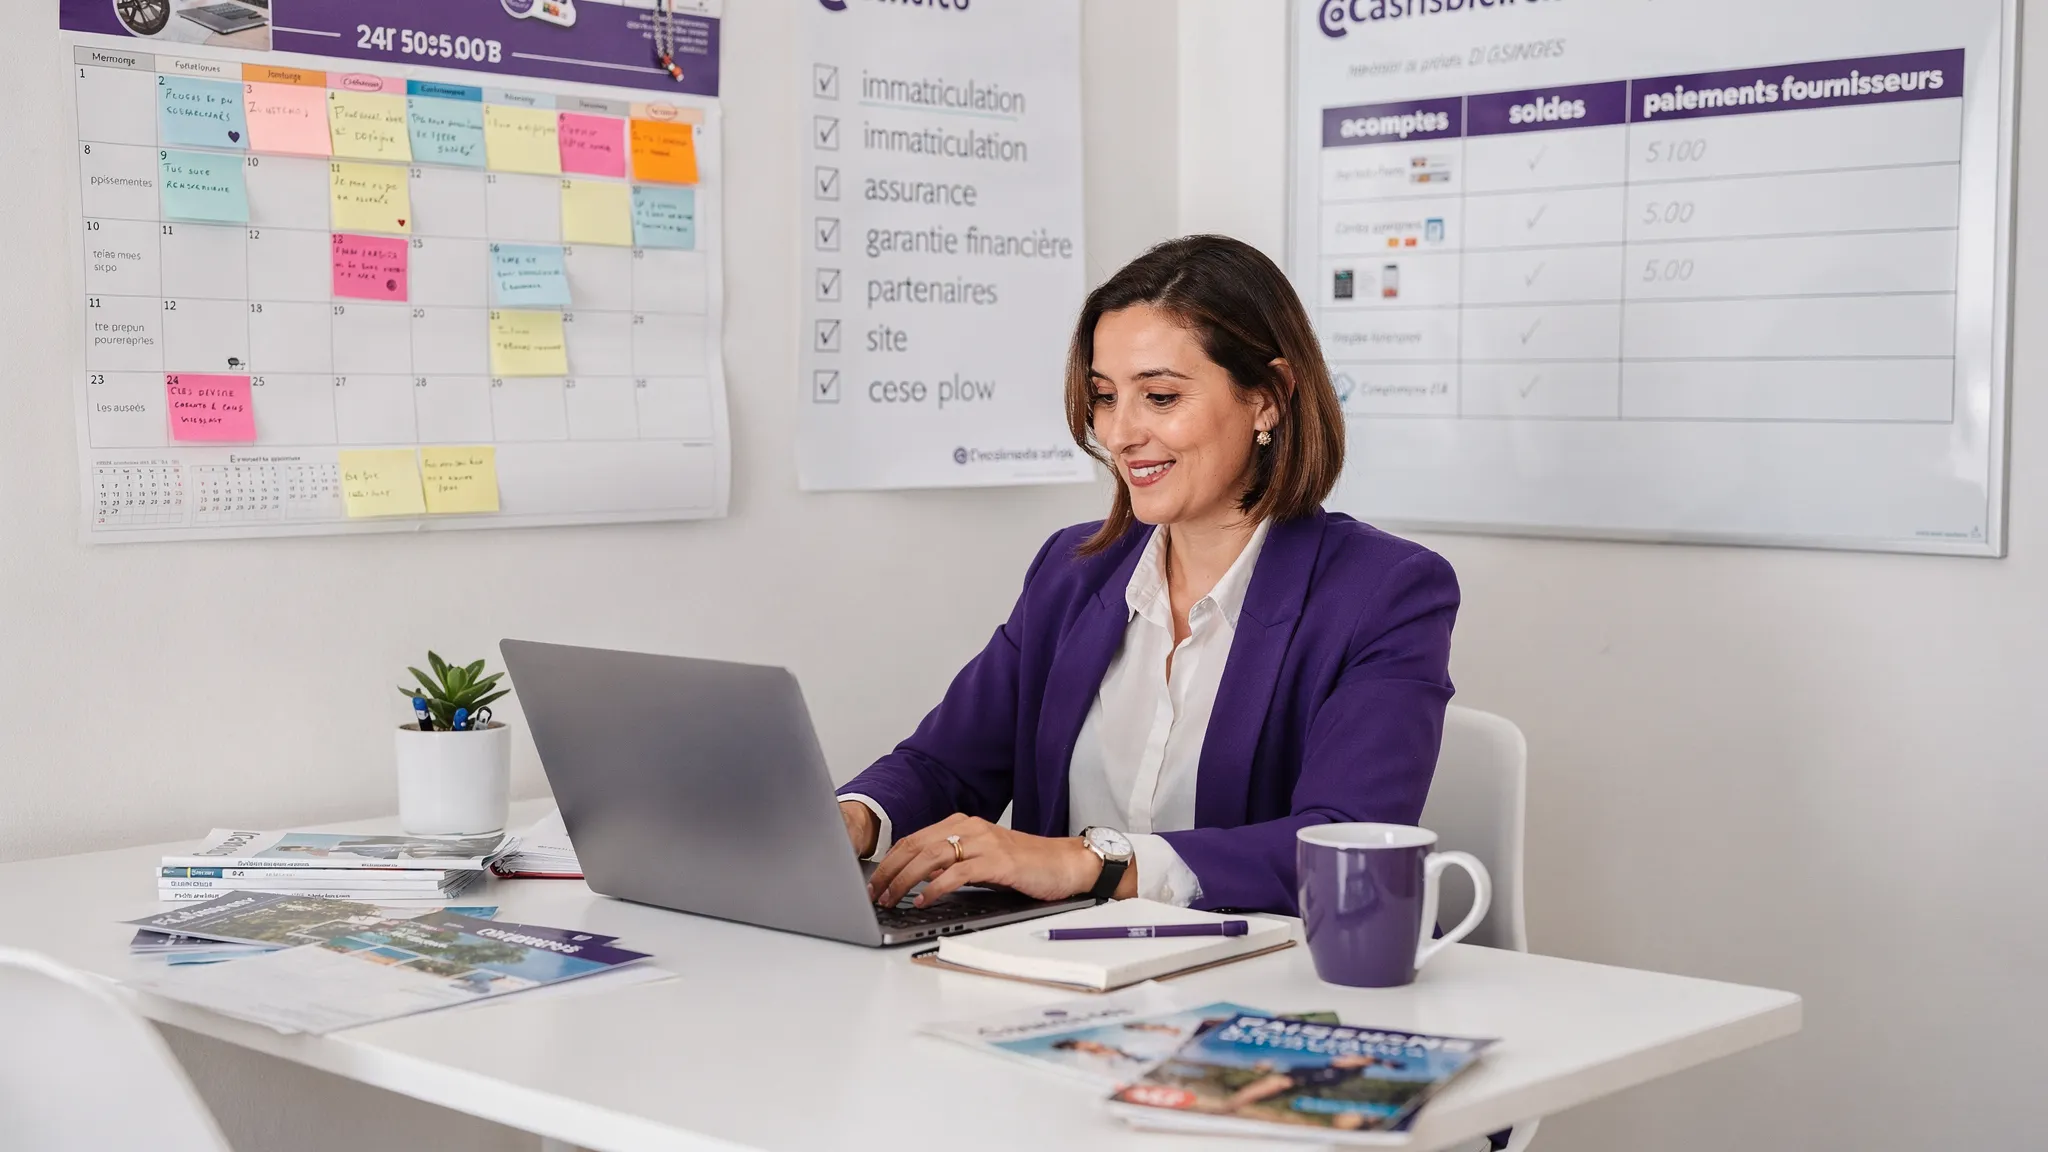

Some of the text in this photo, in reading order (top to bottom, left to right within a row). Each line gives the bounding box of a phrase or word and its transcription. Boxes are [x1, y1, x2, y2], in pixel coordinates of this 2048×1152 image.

[80, 68, 85, 78] 1
[158, 76, 165, 85] 2
[246, 84, 253, 94] 3
[861, 69, 1026, 115] immatriculation
[1643, 68, 1944, 118] paiements fournisseurs
[1508, 96, 1587, 125] soldes
[1340, 110, 1450, 139] acomptes
[863, 120, 1028, 162] immatriculation
[84, 145, 91, 154] 8
[160, 150, 167, 160] 9
[247, 157, 259, 167] 10
[331, 164, 340, 172] 11
[410, 169, 422, 178] 12
[864, 176, 977, 207] assurance
[86, 221, 100, 231] 10
[162, 226, 173, 235] 11
[249, 230, 260, 240] 12
[866, 226, 1073, 260] garantie financière
[867, 277, 998, 309] partenaires
[89, 298, 101, 308] 11
[164, 301, 176, 310] 12
[334, 306, 344, 316] 19
[866, 324, 908, 352] site
[90, 374, 104, 385] 23
[166, 375, 179, 385] 24
[252, 377, 265, 387] 25
[335, 377, 346, 386] 27
[938, 373, 997, 410] plow
